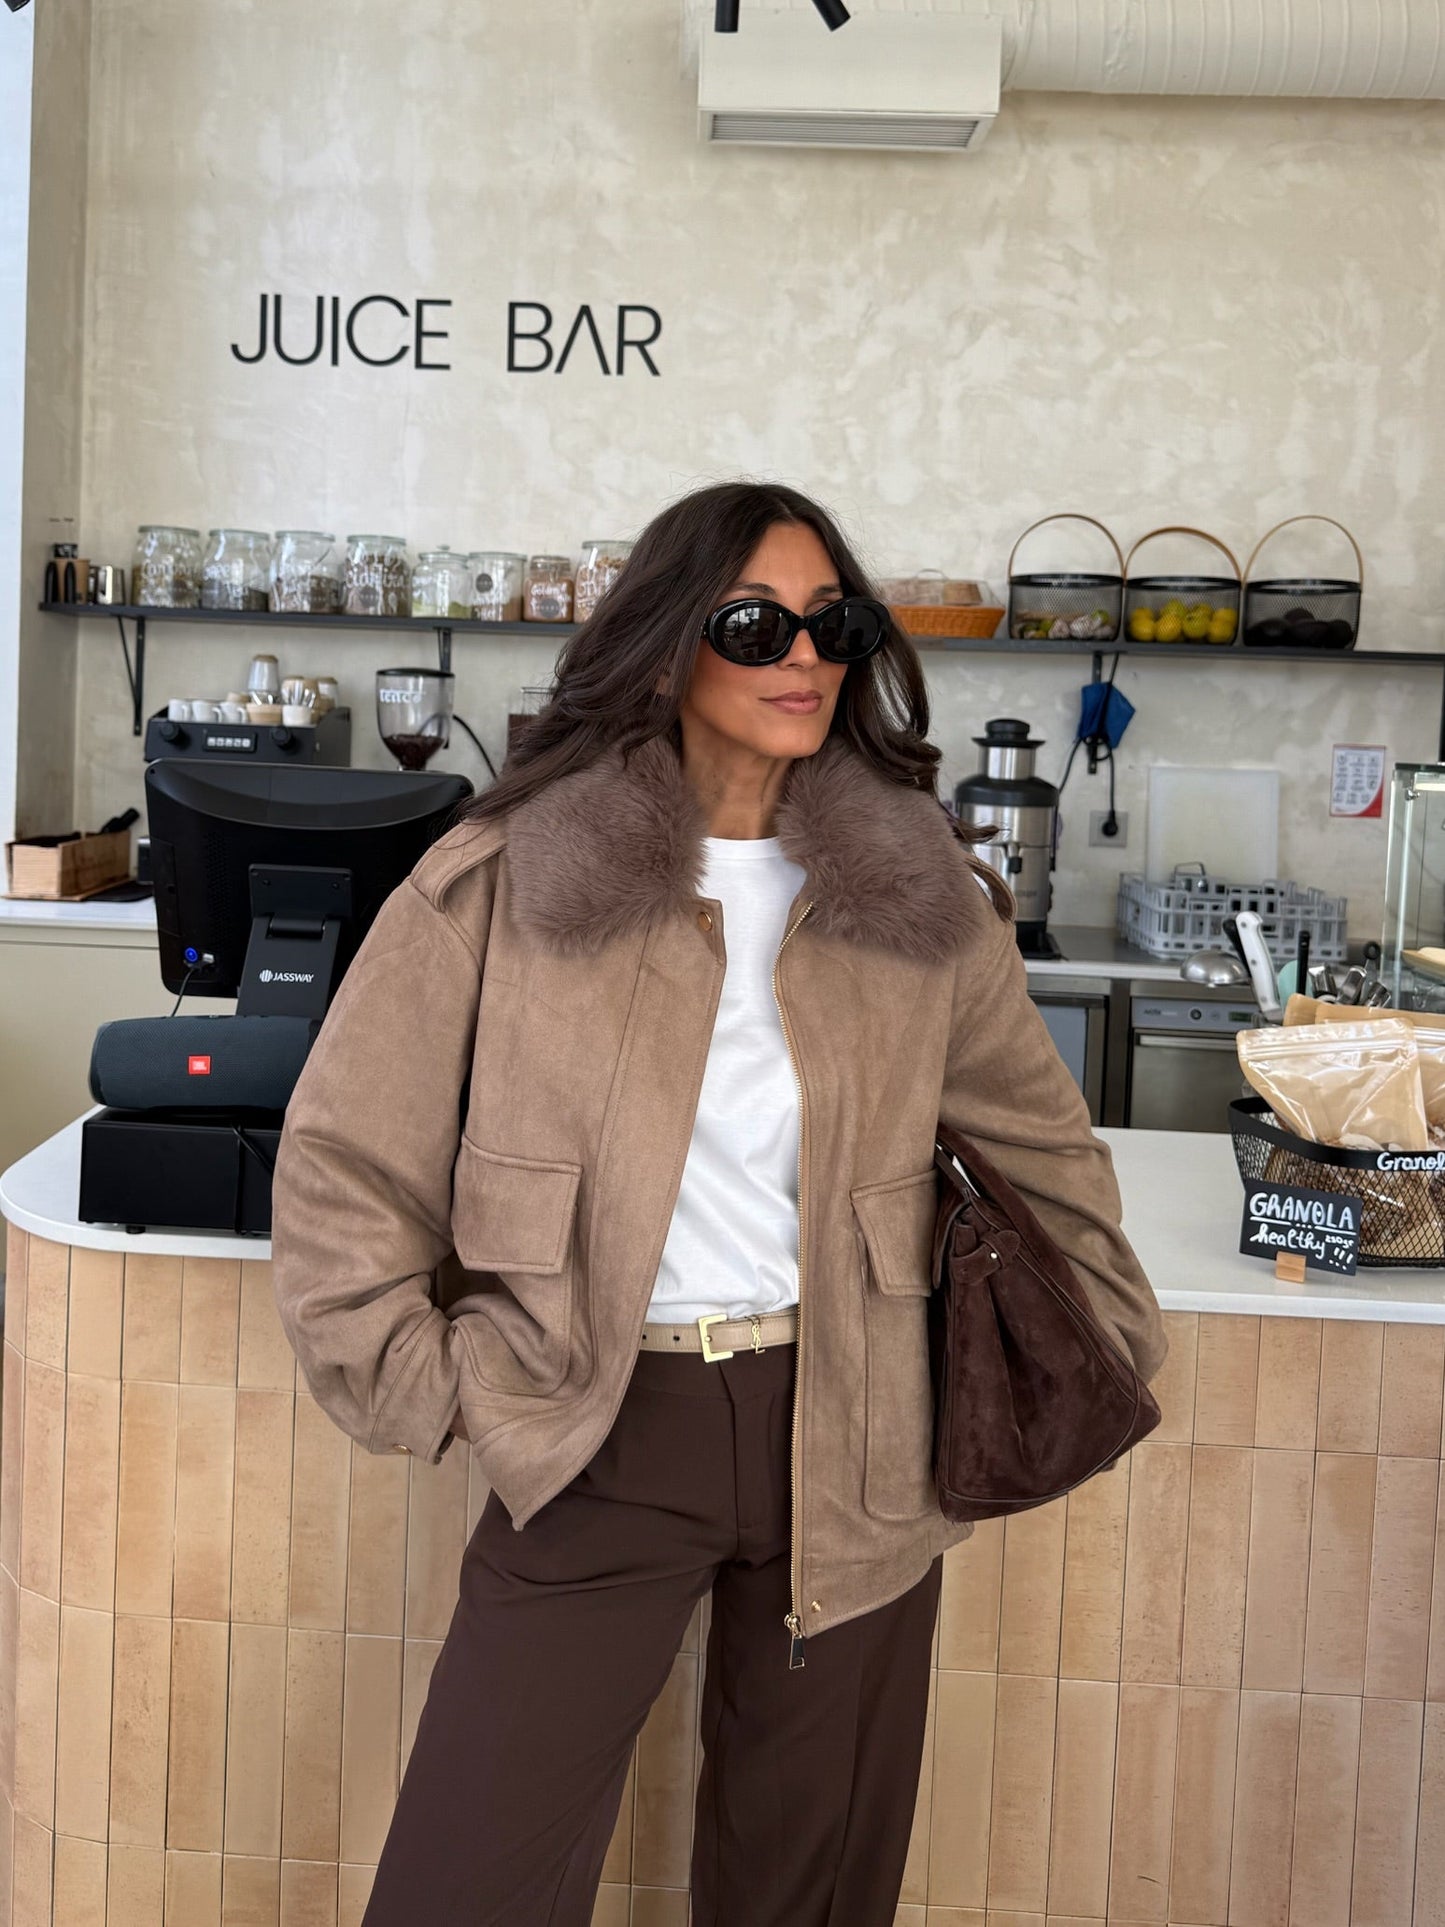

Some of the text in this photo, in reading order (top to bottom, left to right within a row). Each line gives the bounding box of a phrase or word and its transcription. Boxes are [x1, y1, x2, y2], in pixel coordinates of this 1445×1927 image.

[231, 293, 662, 377] JUICE BAR
[273, 972, 315, 983] JASSWAY
[1249, 1192, 1354, 1230] GRANOLA
[1249, 1223, 1326, 1260] healthy
